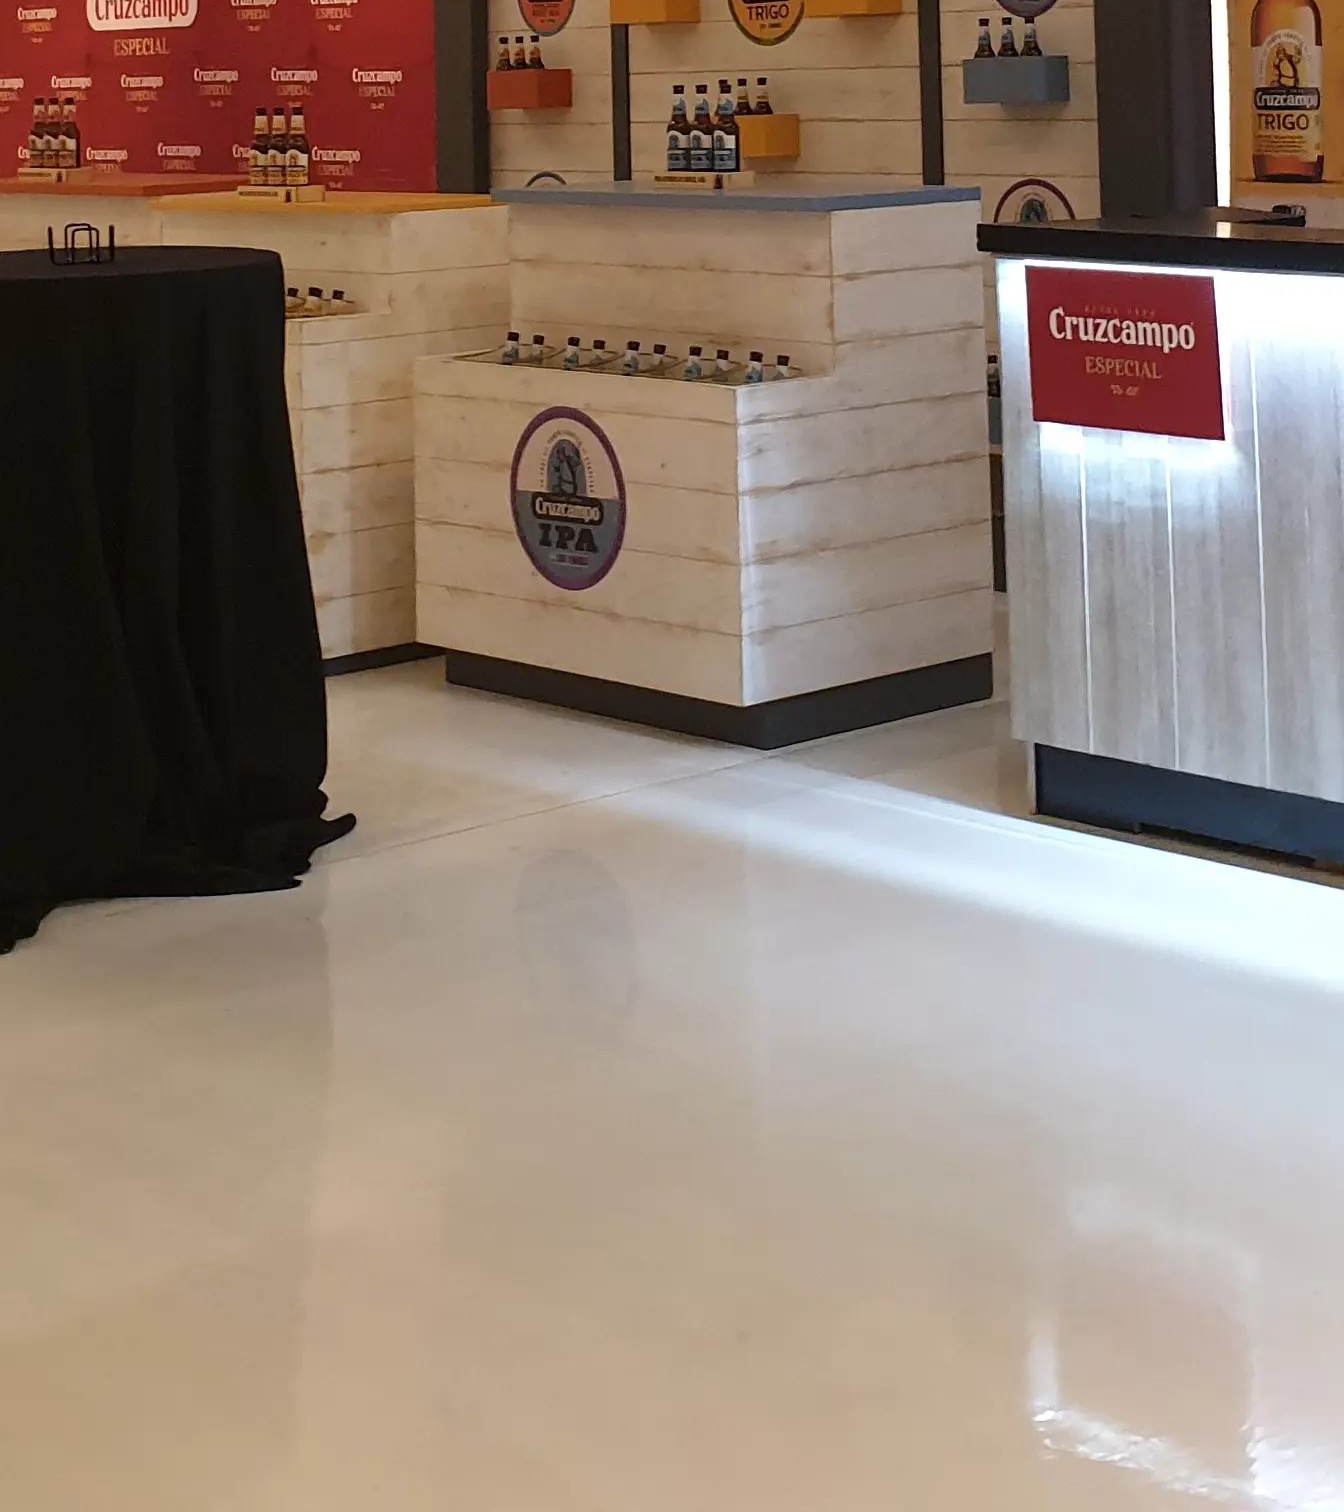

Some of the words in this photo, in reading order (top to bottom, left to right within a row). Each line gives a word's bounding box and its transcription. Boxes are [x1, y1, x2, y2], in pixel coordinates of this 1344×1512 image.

[746, 3, 790, 21] TRIGO
[114, 37, 171, 56] ESPECIAL
[1256, 91, 1318, 109] Cruzcampo
[1256, 113, 1309, 131] TRIGO
[1048, 306, 1195, 354] Cruzcampo
[1085, 356, 1162, 379] ESPECIAL
[535, 496, 601, 524] Cruzcampo
[538, 523, 600, 554] IPA
